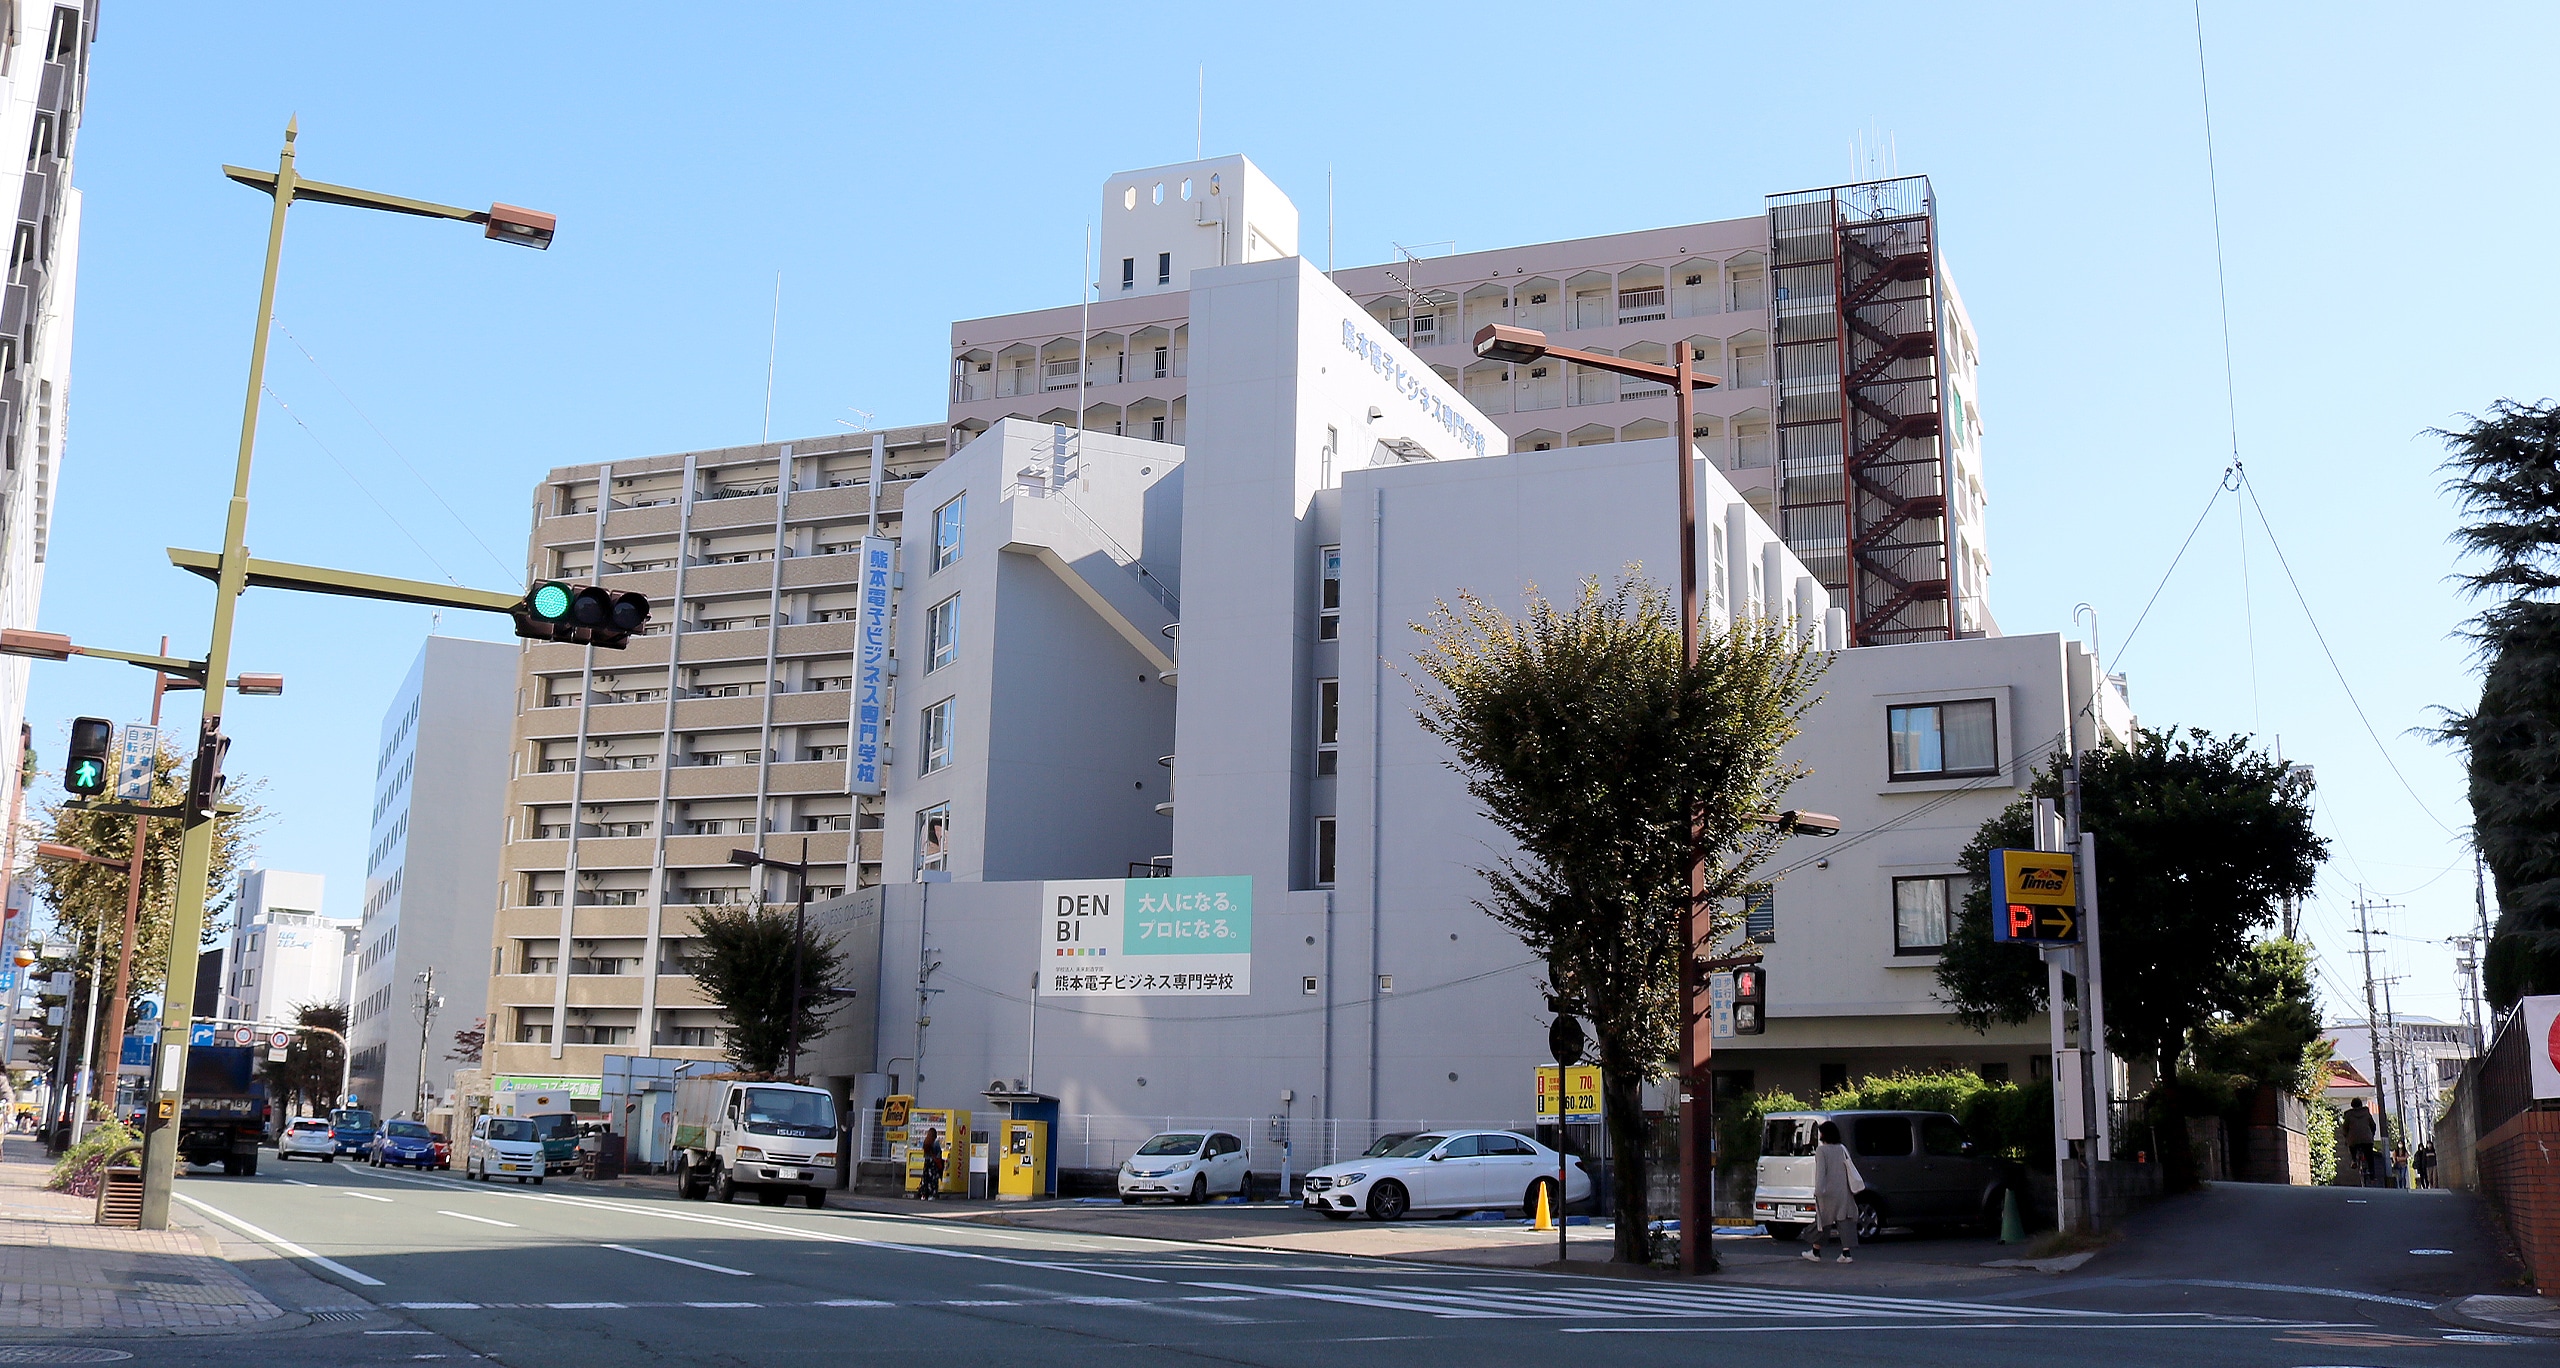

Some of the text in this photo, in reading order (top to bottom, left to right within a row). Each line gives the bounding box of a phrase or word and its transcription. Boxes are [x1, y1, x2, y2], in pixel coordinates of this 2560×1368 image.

[1342, 318, 1485, 457] 熊本電子ビジネス専門学校
[857, 550, 888, 783] 熊本電子ビジネス専門学校
[126, 730, 138, 764] 自転車
[2019, 868, 2067, 890] Times
[1057, 894, 1110, 917] DEN
[1138, 892, 1238, 913] 大人になる。
[1056, 920, 1080, 942] BI
[1138, 919, 1237, 939] プロになる。
[2009, 905, 2033, 937] P
[1055, 973, 1234, 991] 熊本電子ビジネス専門学校
[1580, 1076, 1593, 1089] 770
[1579, 1095, 1593, 1109] 220
[776, 1128, 805, 1137] ISUZU
